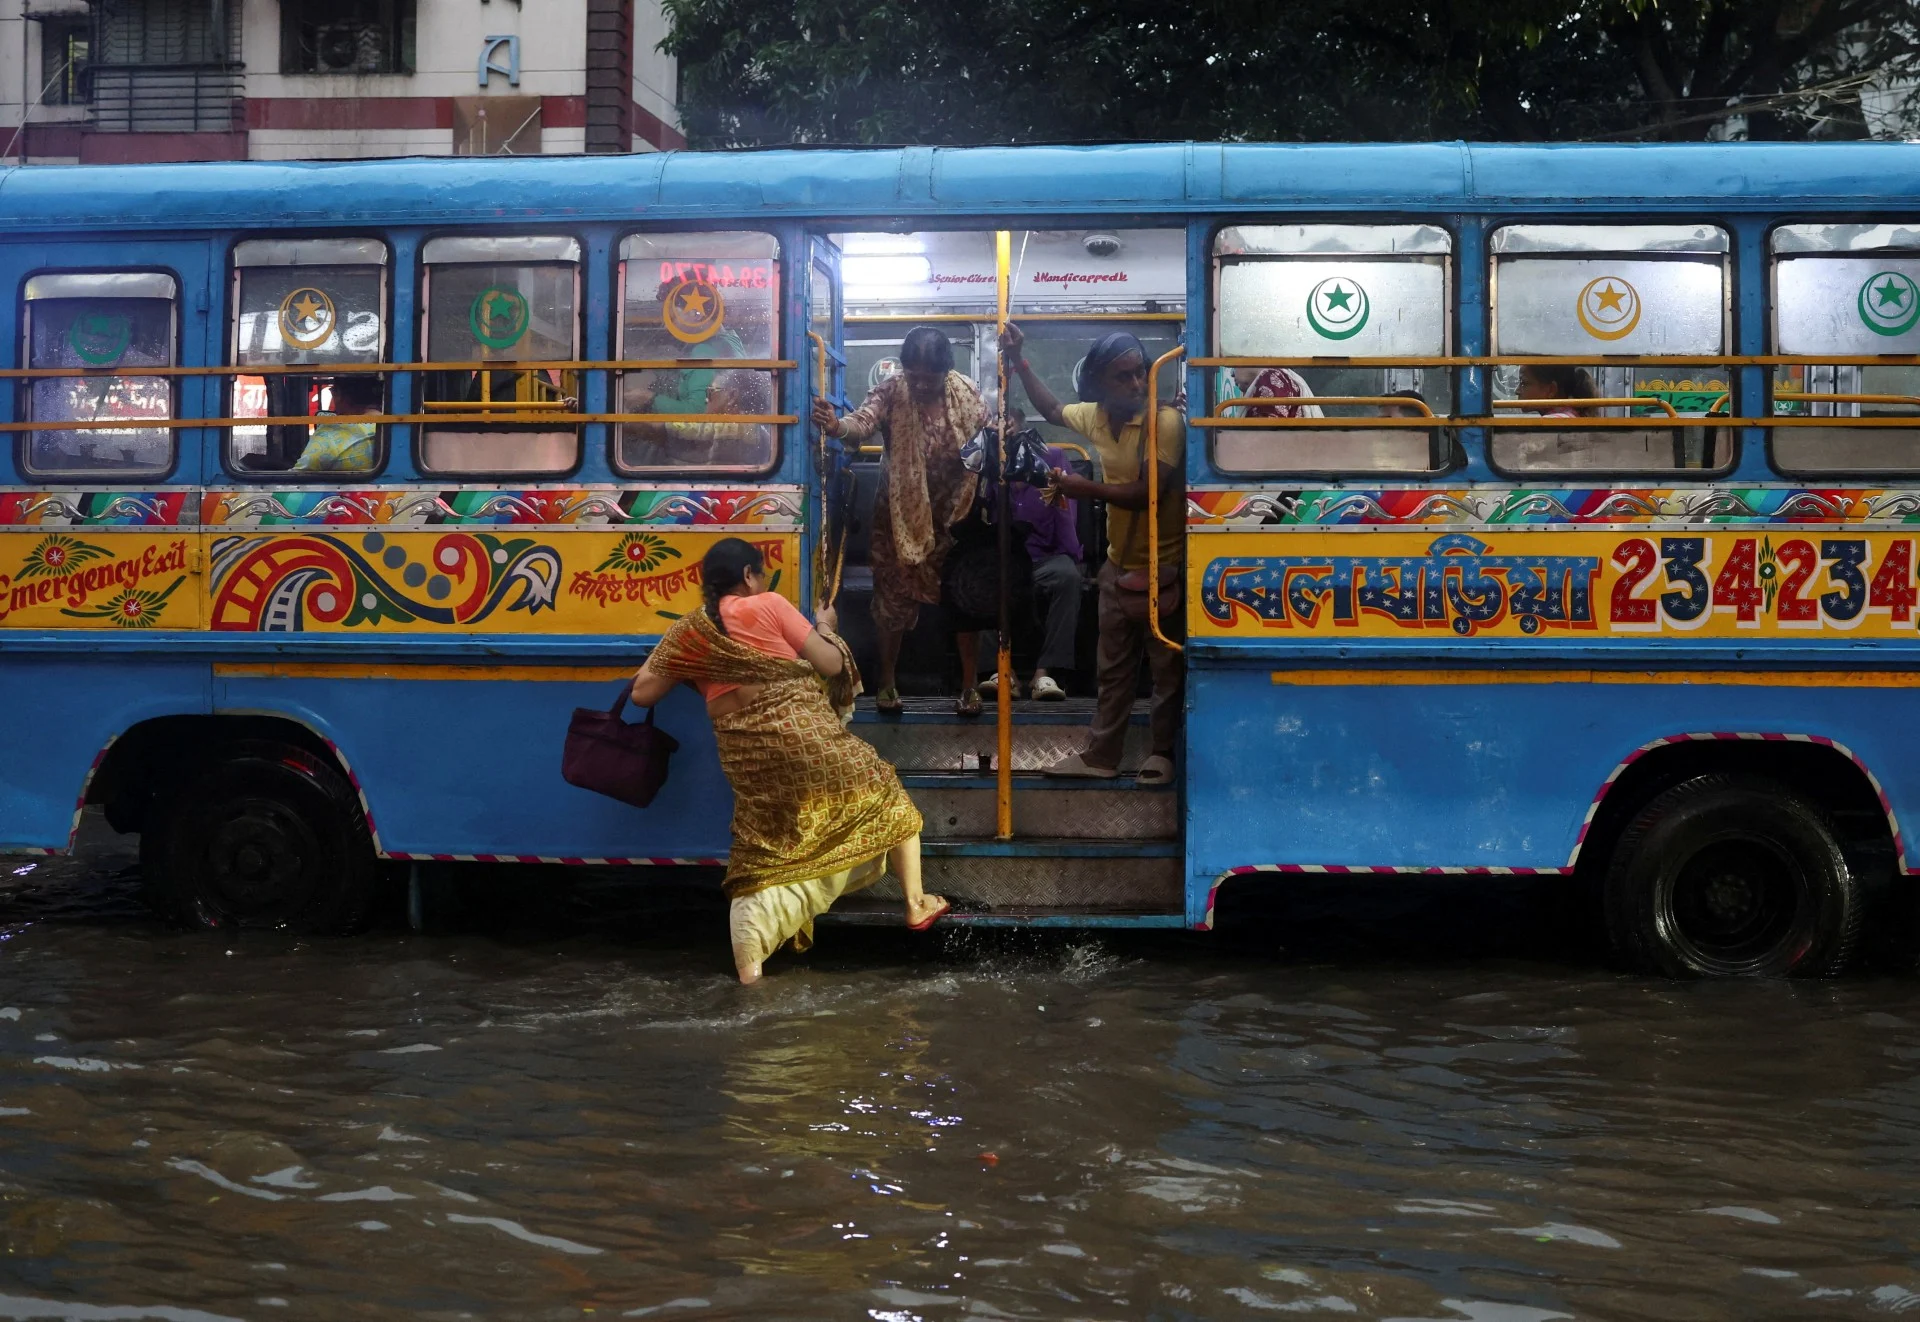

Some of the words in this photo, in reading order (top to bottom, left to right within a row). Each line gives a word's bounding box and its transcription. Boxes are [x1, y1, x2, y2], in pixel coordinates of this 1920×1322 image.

[142, 538, 188, 577] Exit
[1610, 537, 1765, 632] 234
[1775, 538, 1920, 630] 234
